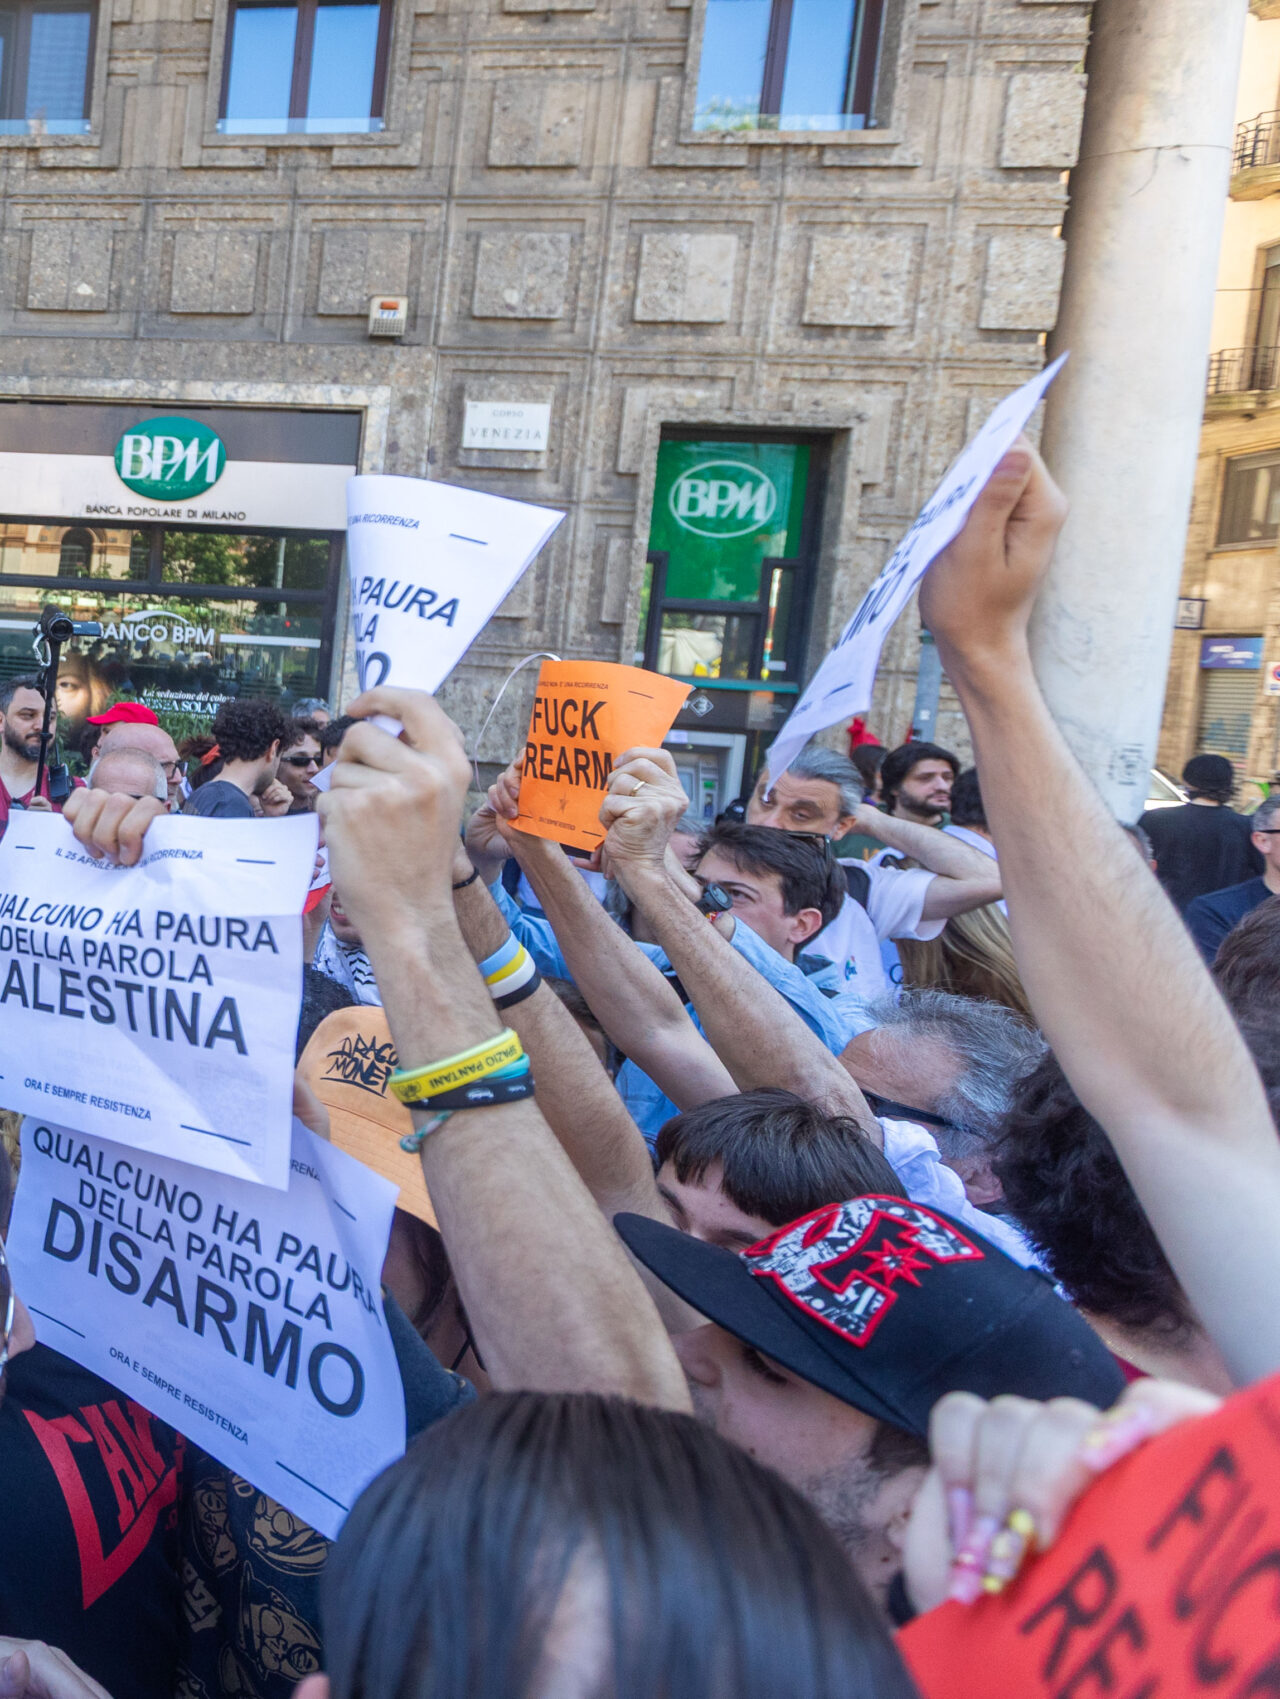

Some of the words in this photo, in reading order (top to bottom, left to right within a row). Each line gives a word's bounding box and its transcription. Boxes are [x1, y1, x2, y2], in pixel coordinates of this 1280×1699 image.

[470, 427, 542, 440] VENEZIA
[121, 434, 220, 484] BPM
[85, 504, 123, 515] BANCA
[127, 506, 182, 518] POPOLARE
[187, 509, 197, 519] DI
[202, 510, 247, 521] MILANO
[362, 514, 420, 529] RICORRENZA
[677, 479, 771, 521] BPM
[360, 576, 460, 628] PAURA
[100, 621, 168, 643] ANCO
[172, 625, 216, 646] BPM
[156, 689, 196, 701] seduzione
[196, 691, 210, 702] del
[533, 696, 608, 741] FUCK
[523, 741, 613, 792] REARM
[65, 850, 77, 861] 25
[77, 855, 112, 871] APRILE
[109, 909, 143, 939] HA
[154, 910, 280, 955] PAURA
[0, 925, 77, 966] DELLA
[82, 938, 215, 988] PAROLA
[428, 1062, 484, 1090] PANTANI
[24, 1077, 43, 1091] ORA
[44, 1083, 50, 1094] E
[51, 1085, 89, 1105] SEMPRE
[89, 1095, 152, 1121] RESISTENZA
[33, 1125, 204, 1224] QUALCUNO
[212, 1203, 264, 1255] HA
[275, 1231, 383, 1327] PAURA
[78, 1178, 176, 1252] DELLA
[186, 1231, 334, 1332] PAROLA
[41, 1196, 367, 1419] DISARMO
[108, 1346, 131, 1368] ORA
[141, 1367, 183, 1401] SEMPRE
[183, 1394, 250, 1446] RESISTENZA
[1144, 1442, 1280, 1699] FUC
